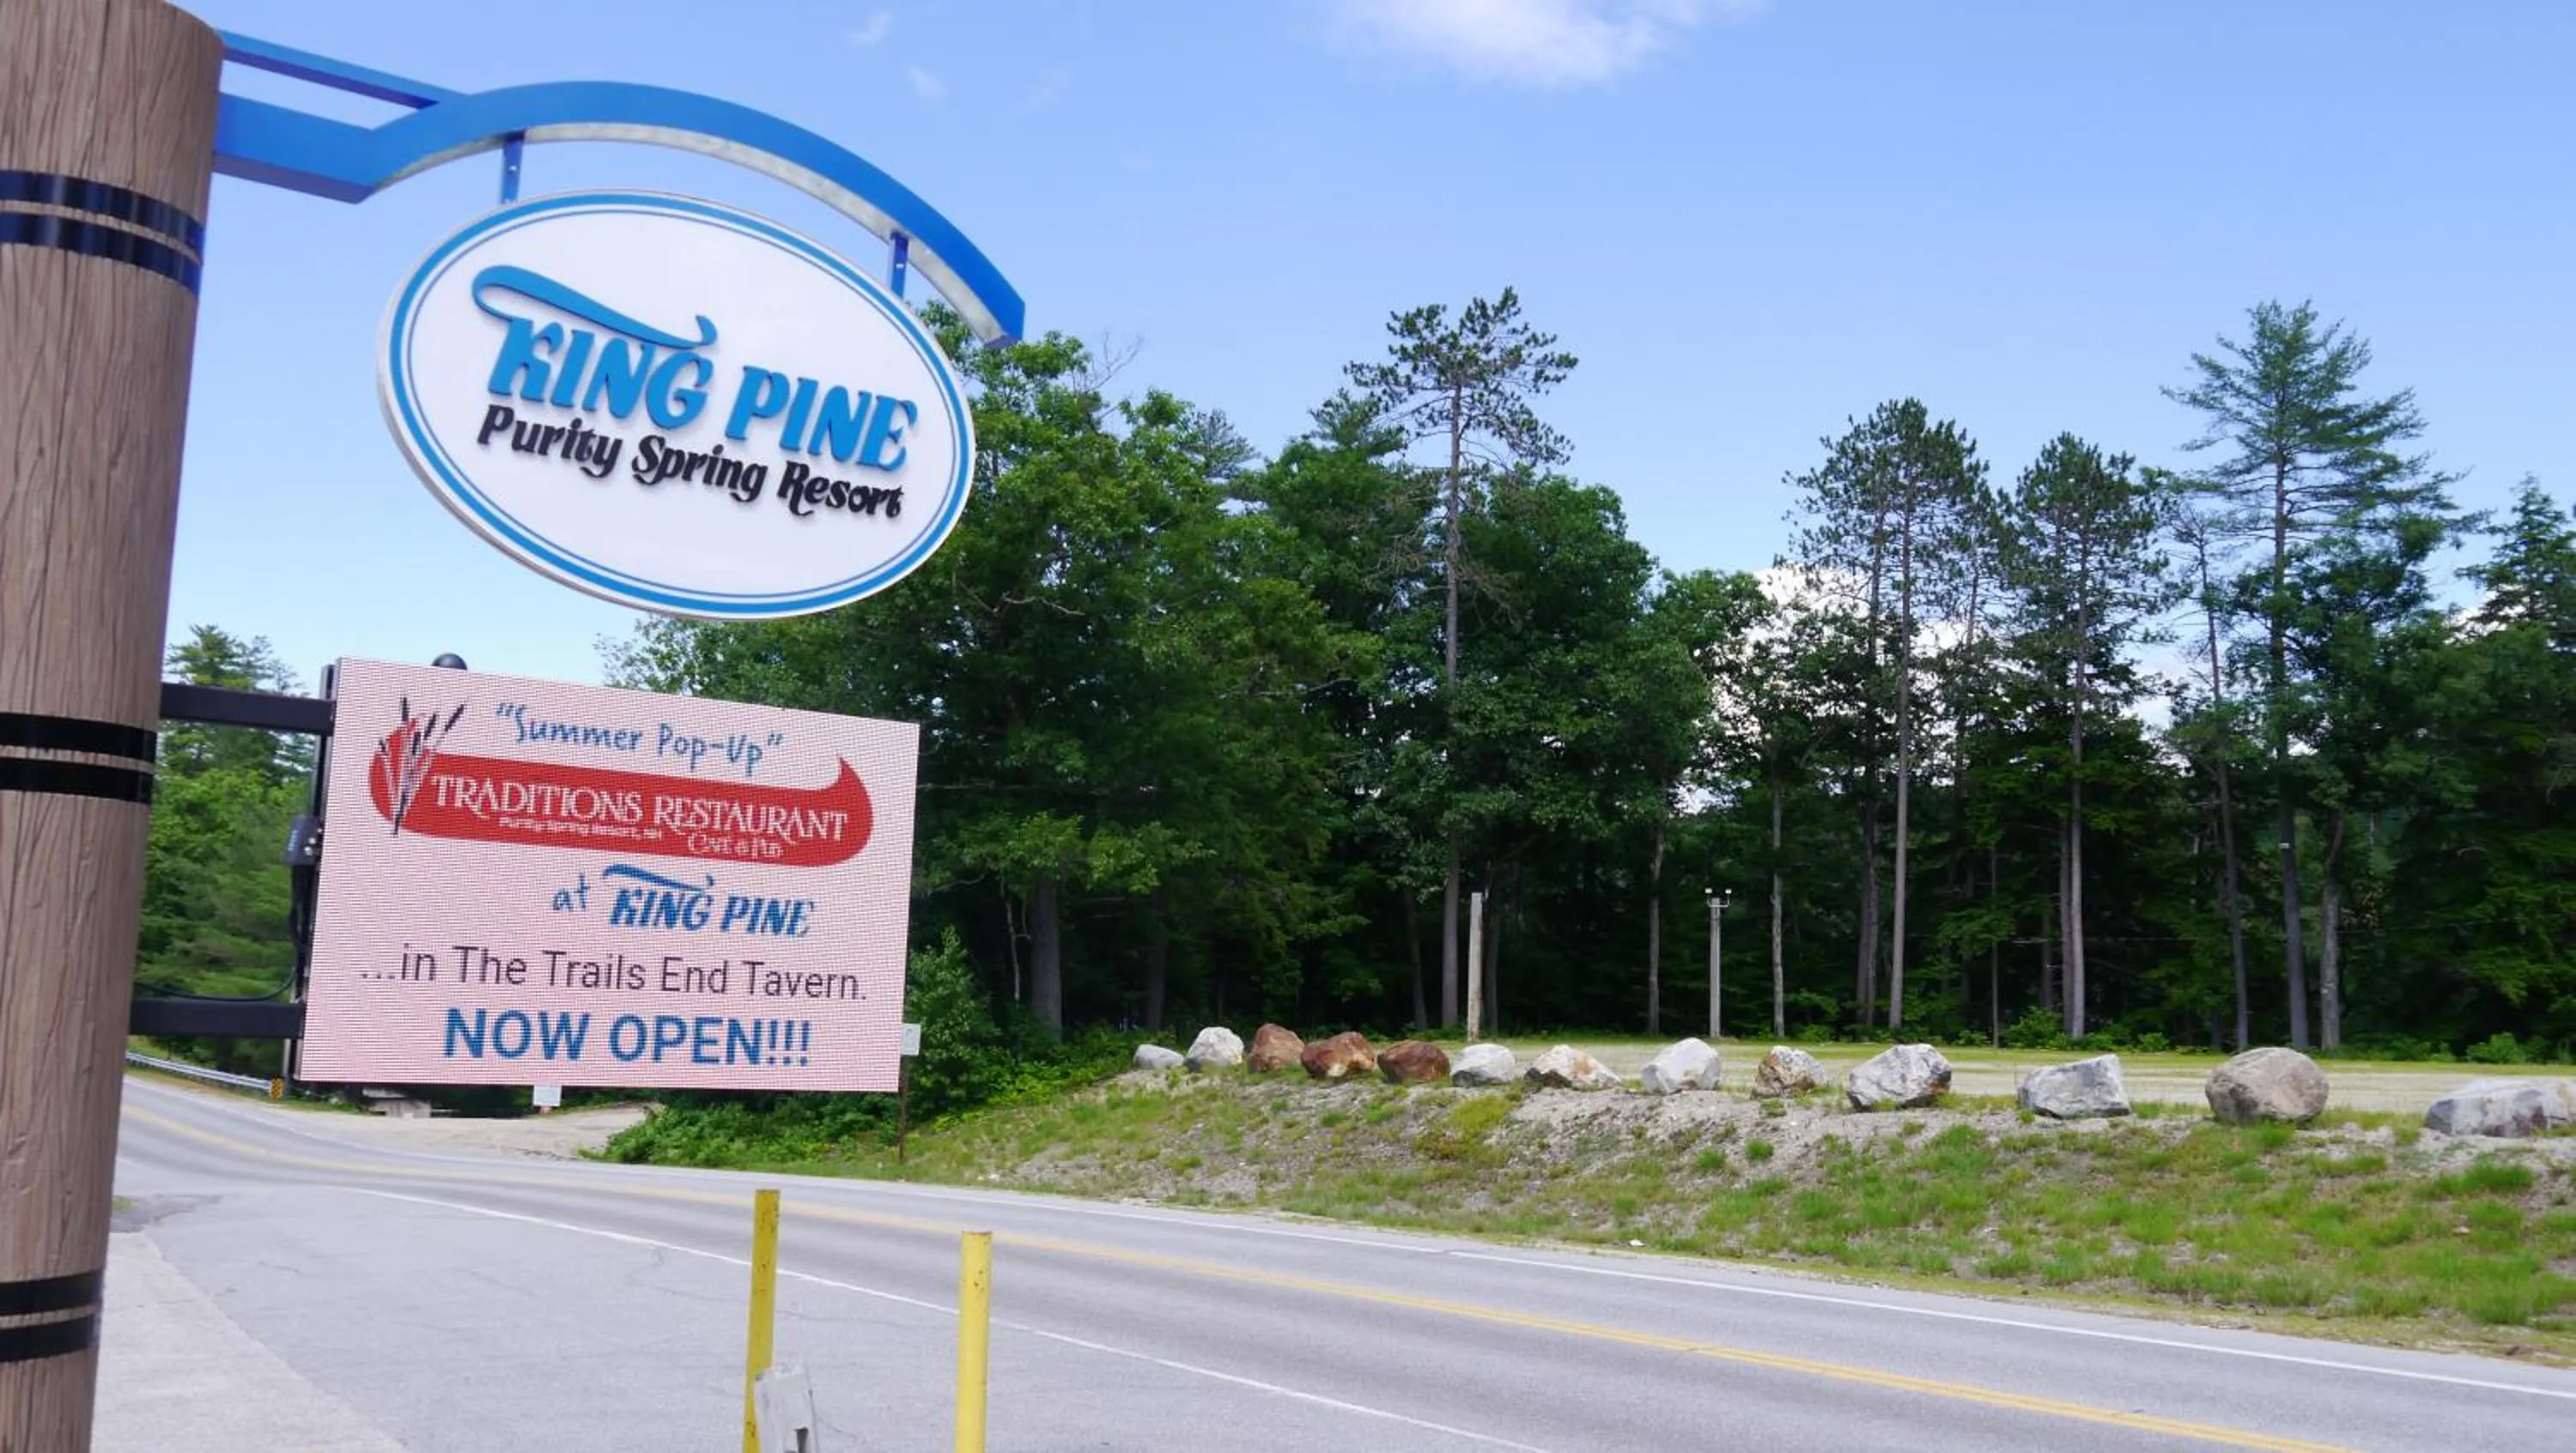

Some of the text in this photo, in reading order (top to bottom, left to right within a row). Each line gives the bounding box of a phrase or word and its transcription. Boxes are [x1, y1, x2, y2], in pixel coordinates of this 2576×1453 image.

[471, 265, 918, 472] KING PINE
[477, 404, 907, 519] Purity Spring Resort
[431, 775, 849, 846] TRADITIONS RESTAURANT
[552, 862, 816, 938] at KING PINE
[361, 943, 867, 1000] ...in The Trails End Tavern.
[443, 1006, 813, 1067] NOW OPEN!!!
